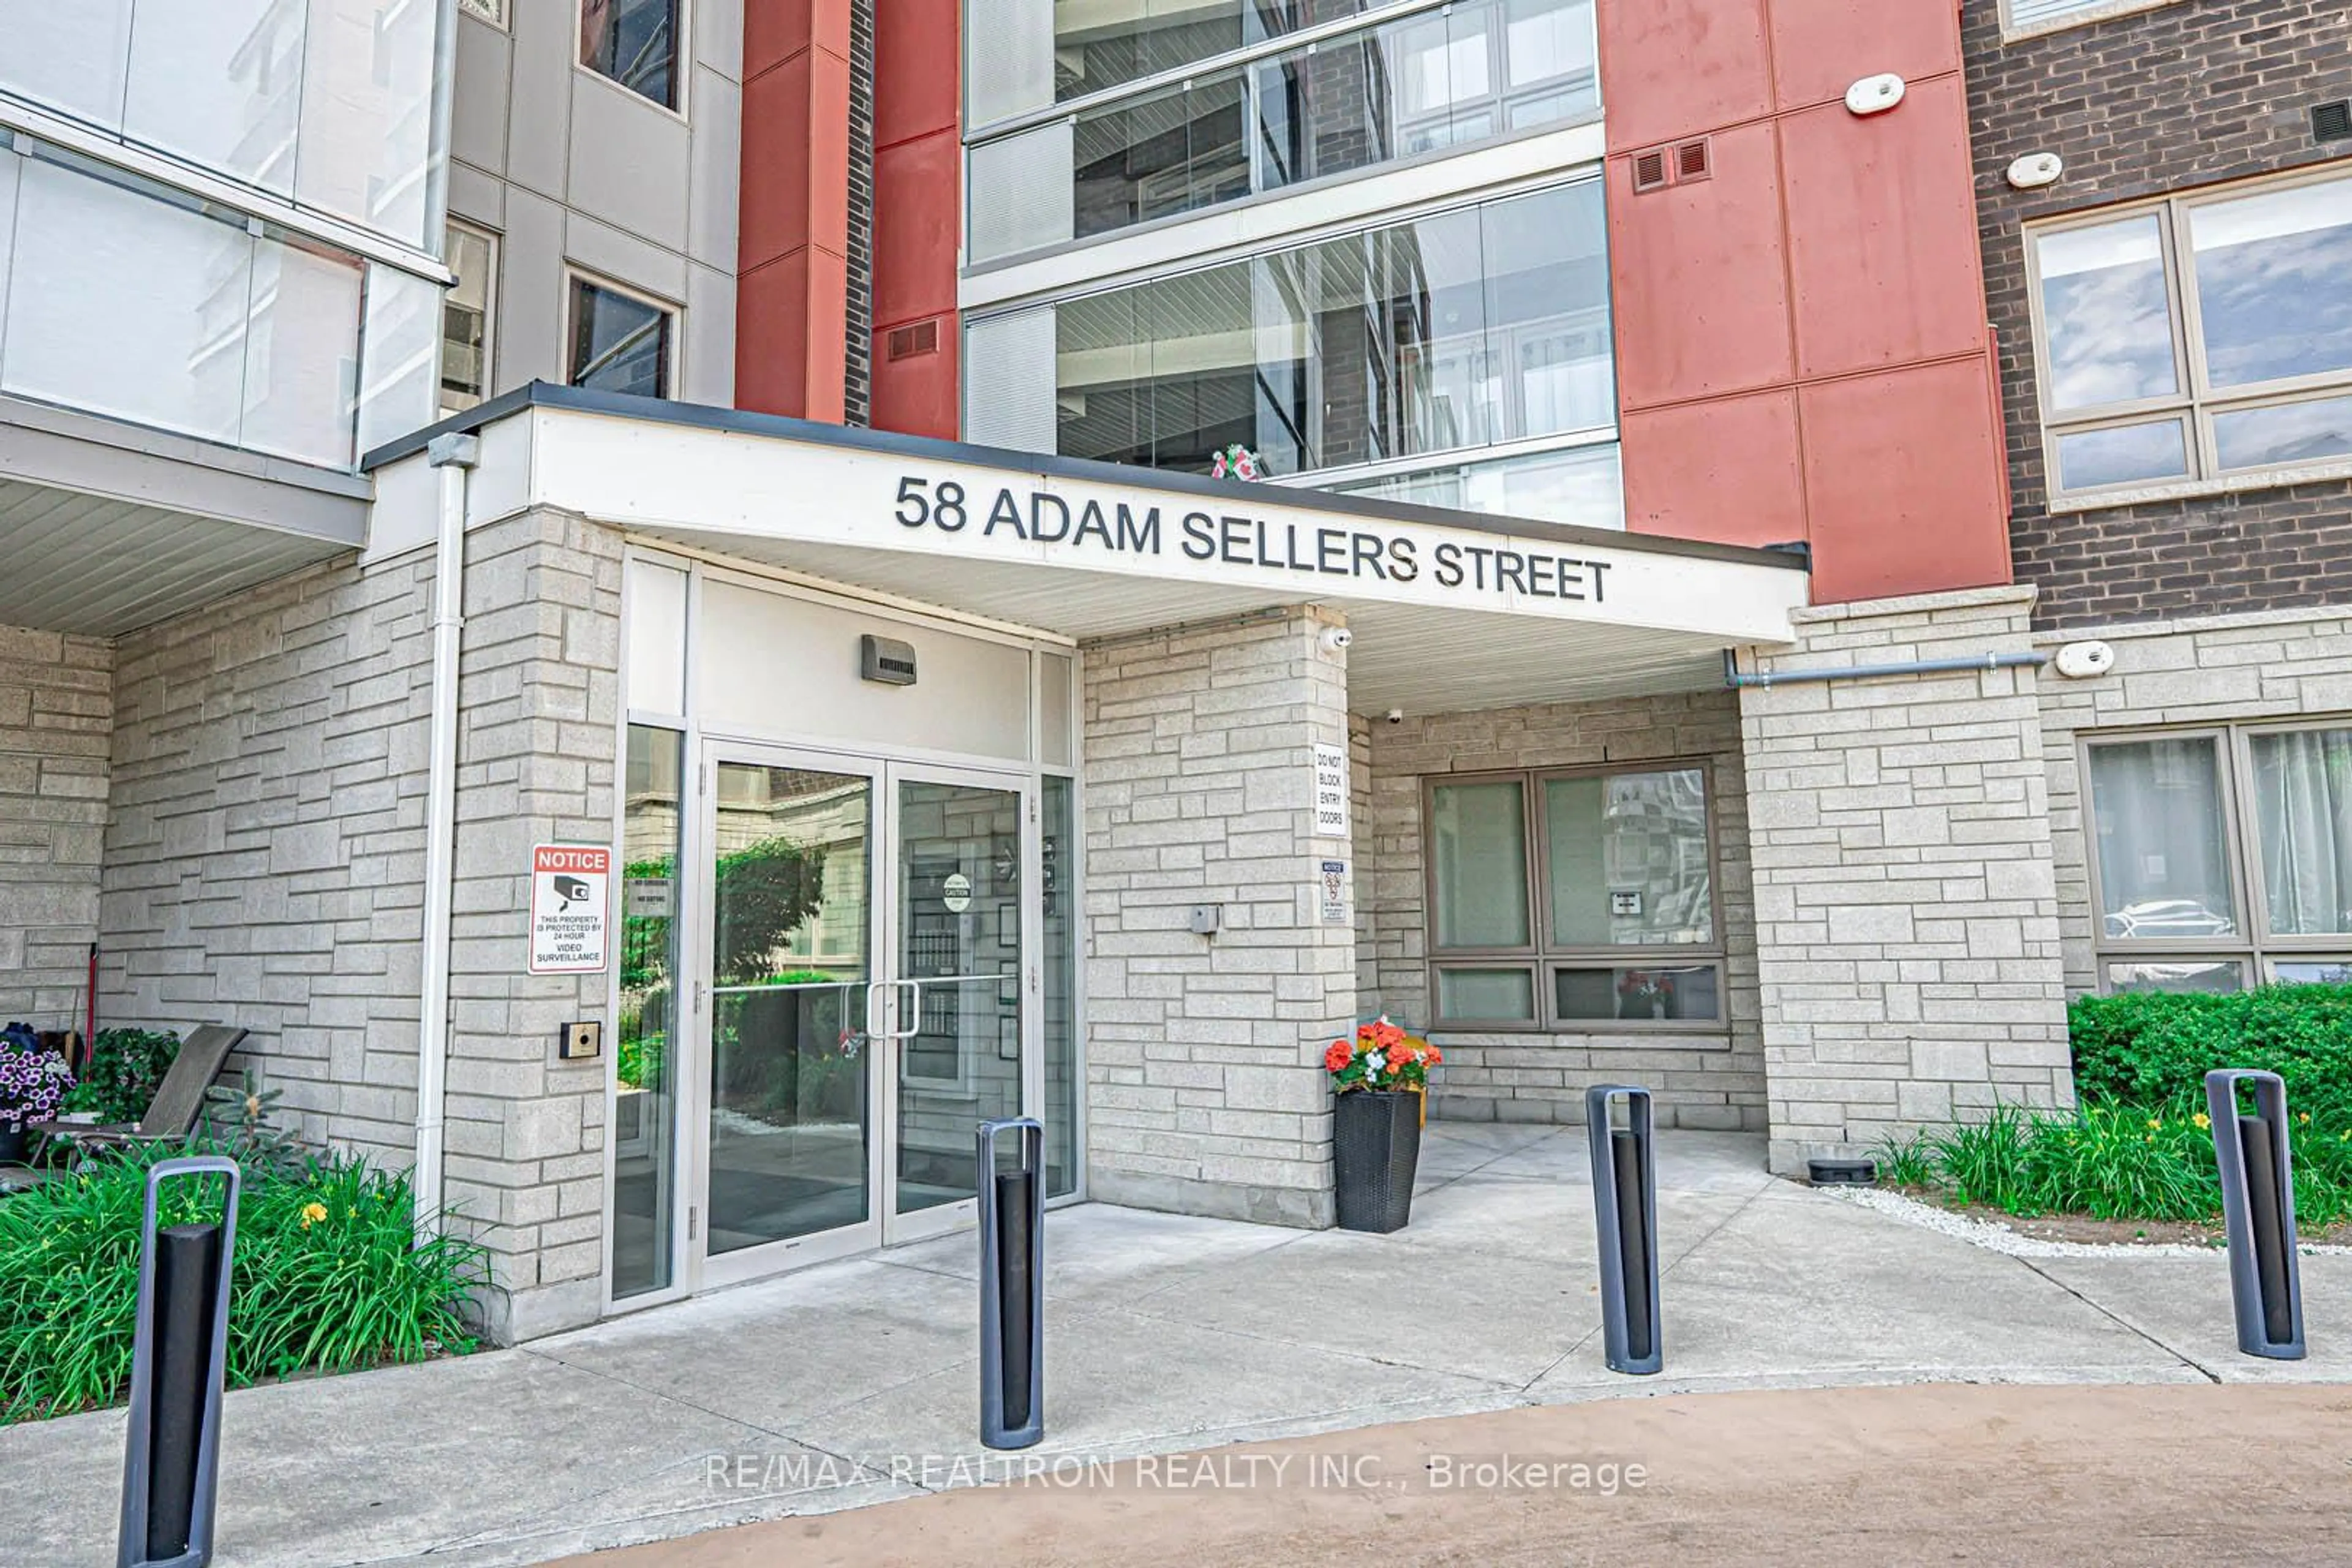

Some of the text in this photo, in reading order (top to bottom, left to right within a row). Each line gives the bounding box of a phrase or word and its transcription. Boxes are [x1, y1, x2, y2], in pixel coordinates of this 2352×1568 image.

[895, 476, 1611, 603] 58 ADAM SELLERS STREET
[1318, 753, 1341, 767] DO NOT
[1319, 772, 1340, 786] BLOCK
[1320, 792, 1340, 805] ENTRY
[1319, 811, 1343, 825] DOORS
[538, 851, 605, 869] NOTICE
[537, 952, 600, 962] SURVEILLANCE
